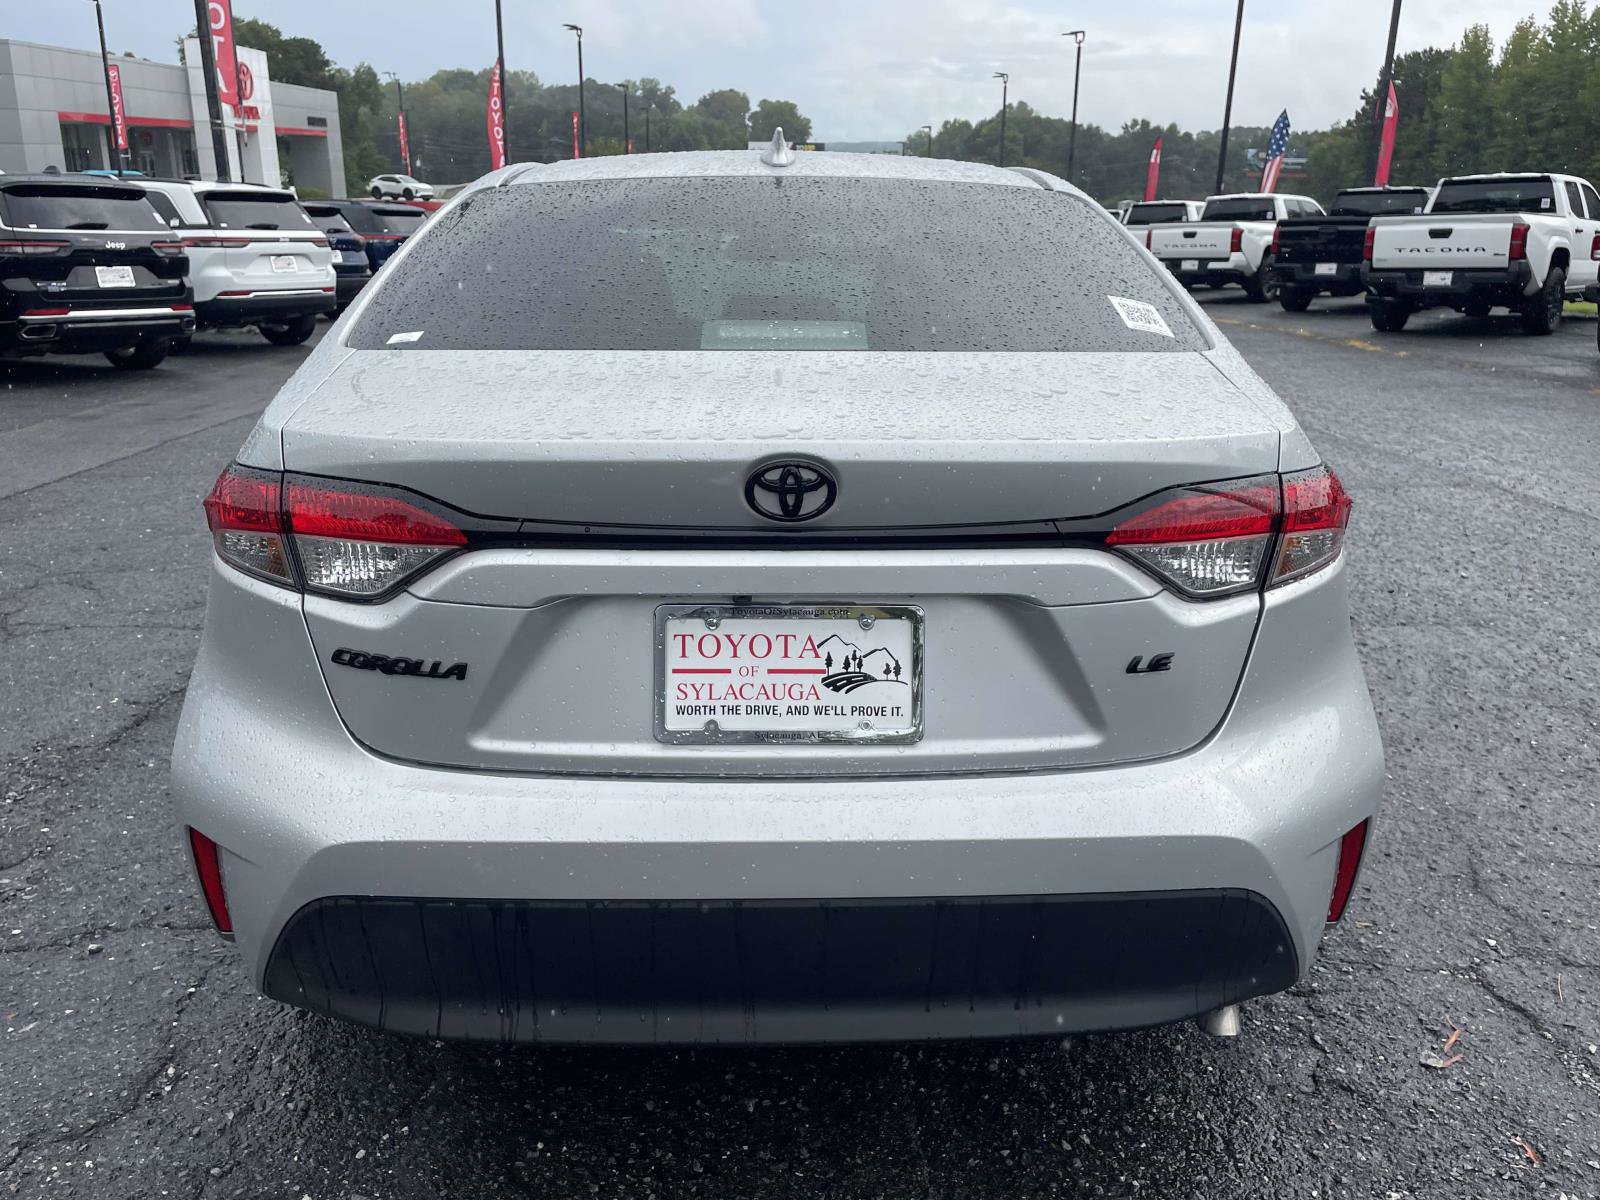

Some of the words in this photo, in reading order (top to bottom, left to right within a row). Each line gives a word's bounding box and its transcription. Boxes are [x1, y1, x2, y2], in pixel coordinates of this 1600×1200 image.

[105, 241, 126, 250] Jeep
[673, 633, 822, 658] TOYOTA
[331, 647, 468, 680] COROLLA
[738, 666, 759, 677] OF
[1126, 652, 1175, 674] LE
[676, 683, 821, 700] SYLACAUGA
[675, 705, 716, 716] WORTH
[720, 705, 741, 715] THE
[745, 705, 782, 717] DRIVE,
[786, 705, 809, 716] AND
[813, 705, 847, 716] WE'LL
[851, 706, 887, 717] PROVE
[891, 706, 904, 717] IT.
